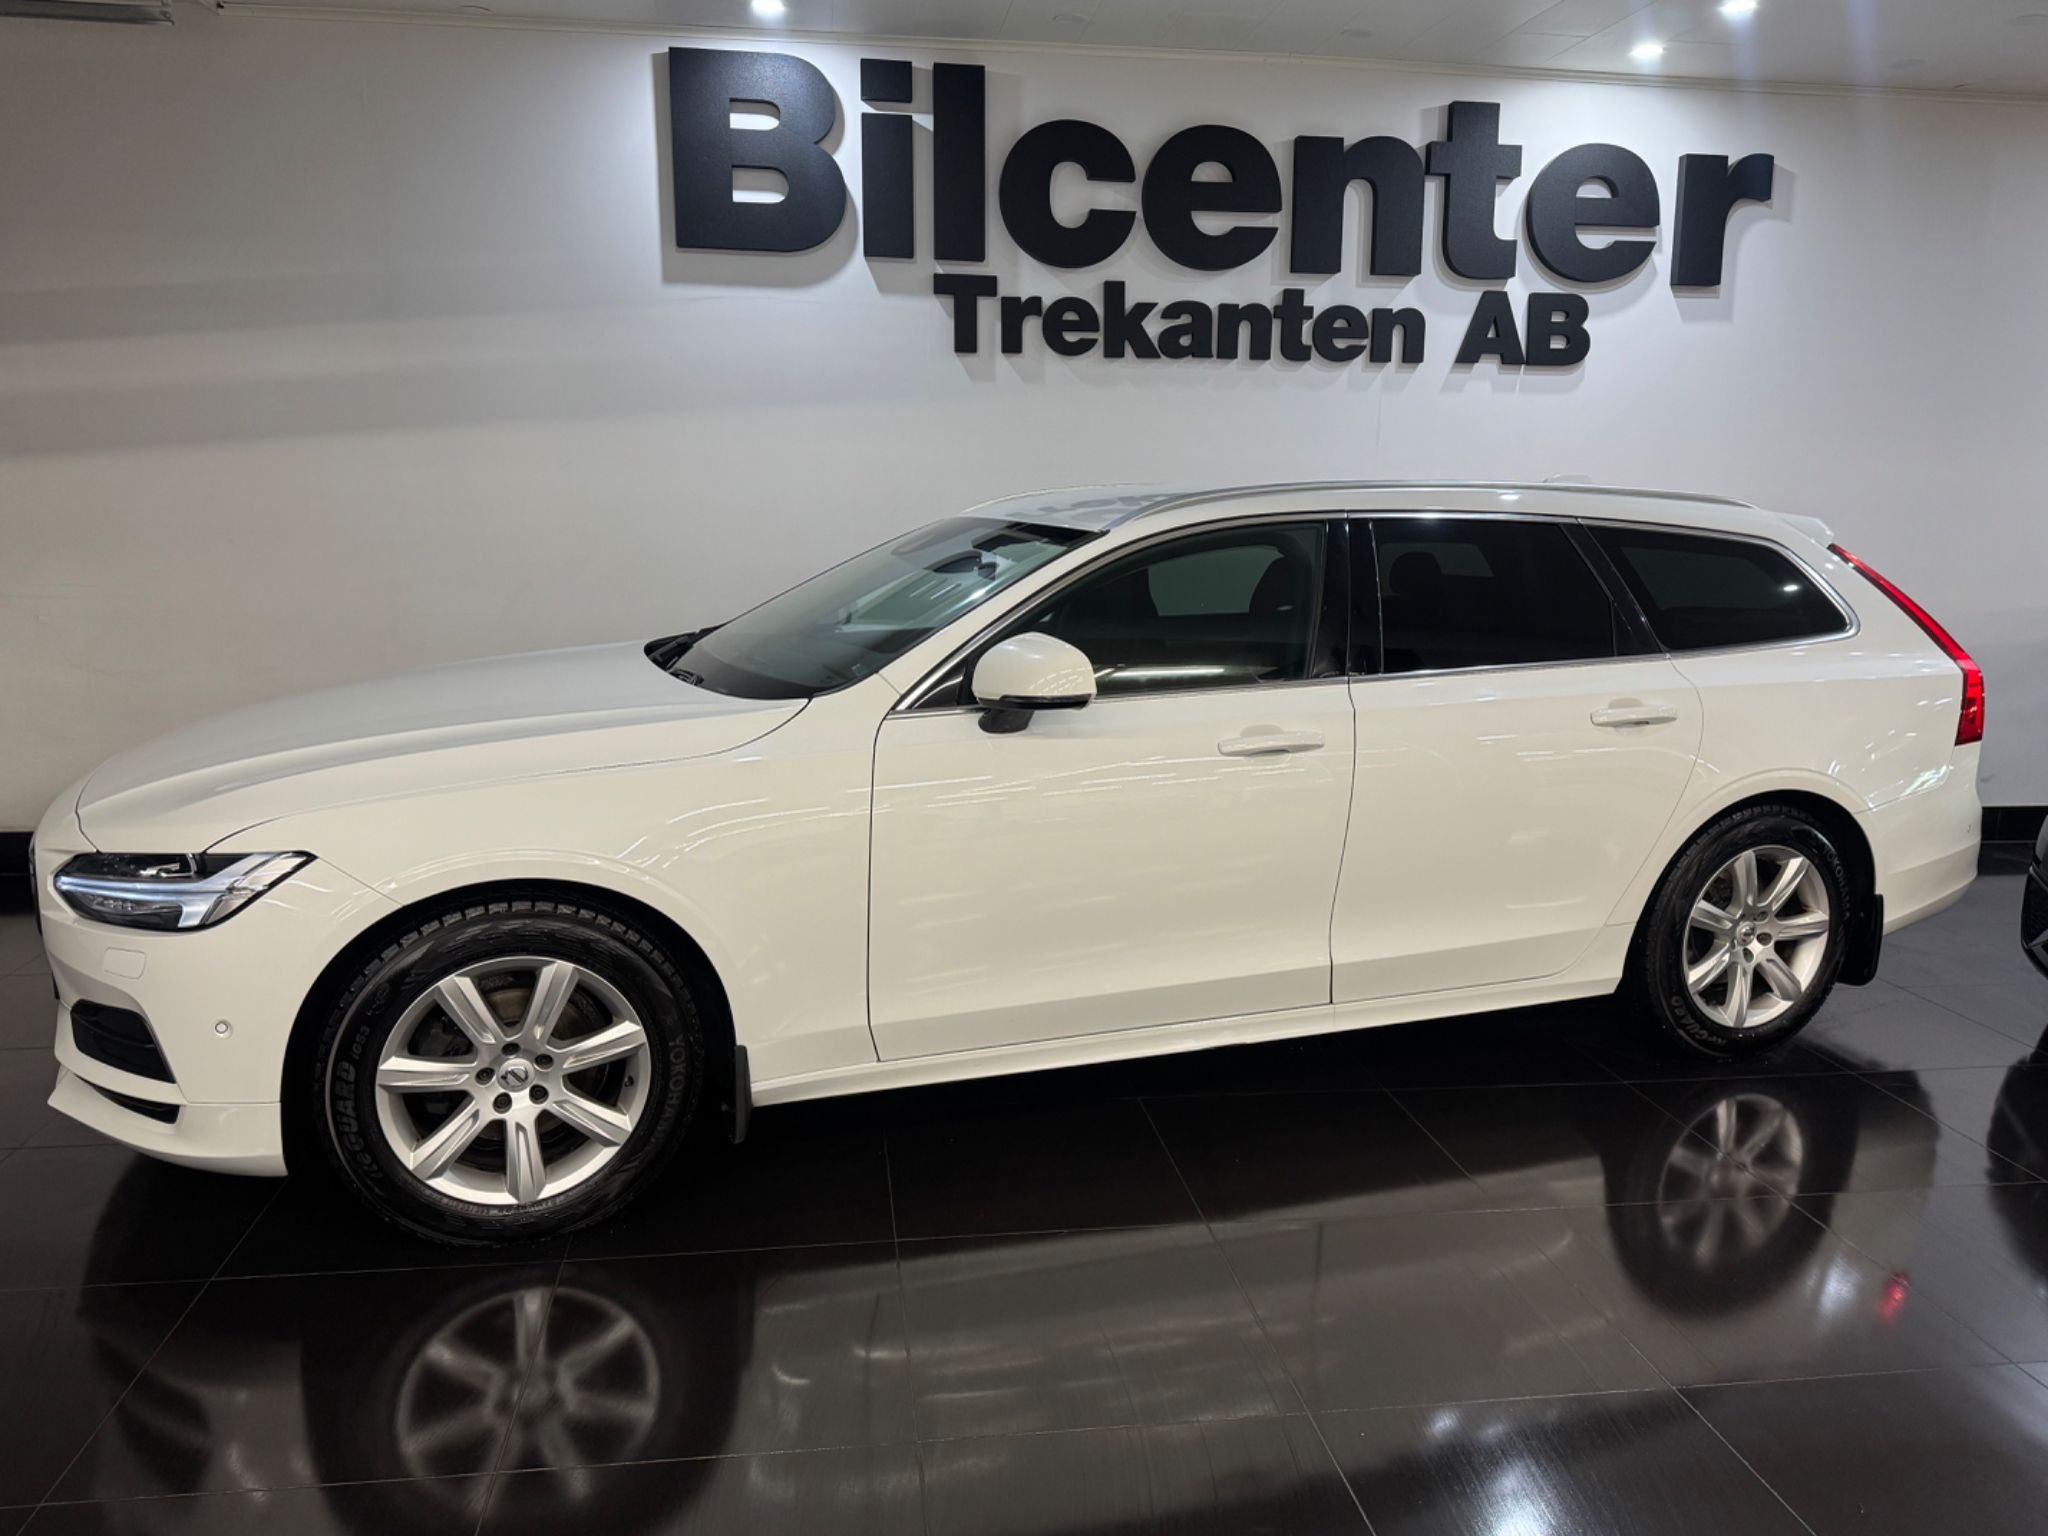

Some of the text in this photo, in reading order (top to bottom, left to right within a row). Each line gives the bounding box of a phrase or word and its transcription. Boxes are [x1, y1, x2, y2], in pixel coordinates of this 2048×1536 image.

[668, 46, 1775, 288] Bilcenter
[932, 272, 1592, 367] Trekanten AB
